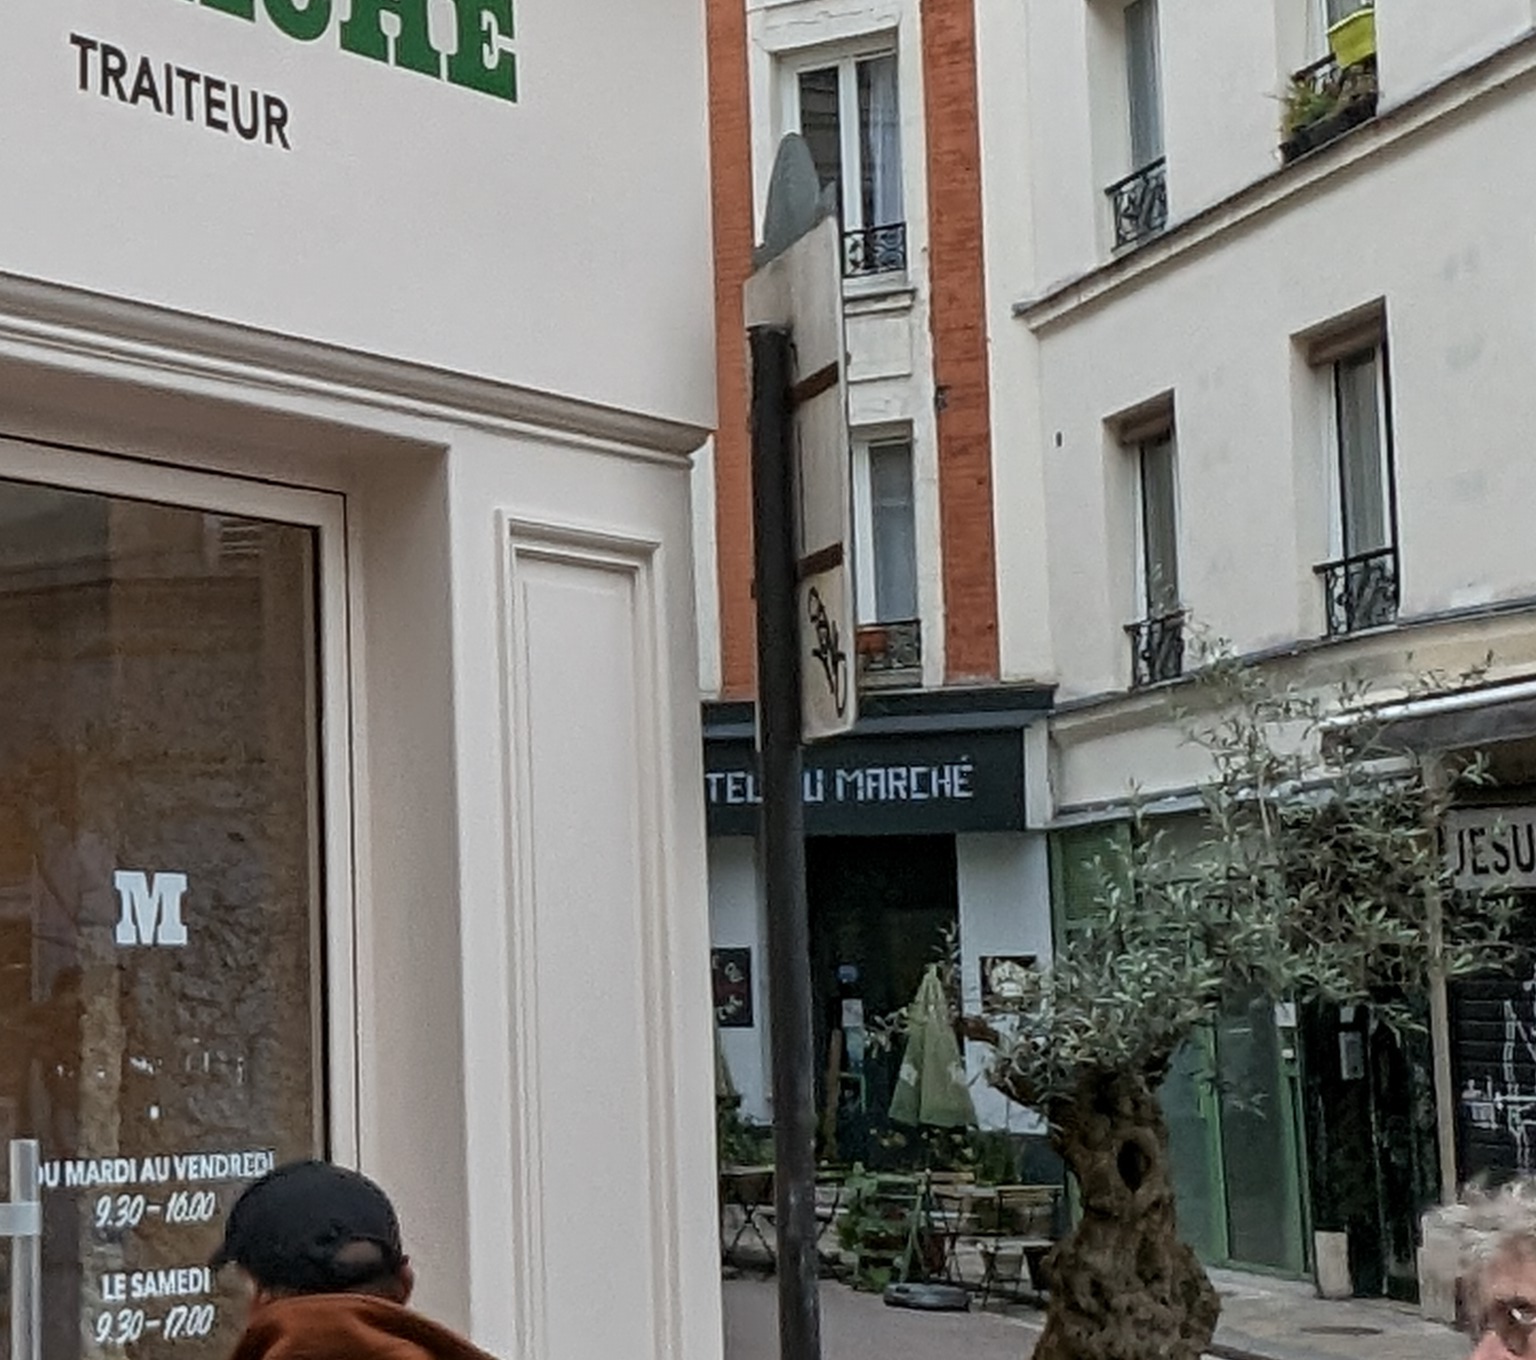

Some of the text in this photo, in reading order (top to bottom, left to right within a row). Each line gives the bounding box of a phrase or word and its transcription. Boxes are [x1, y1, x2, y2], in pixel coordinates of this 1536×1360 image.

[69, 33, 291, 150] TRAITEUR
[705, 770, 763, 803] TEL
[835, 755, 973, 802] MARCHÉ
[114, 871, 188, 945] M
[65, 1157, 136, 1186] MARDI
[140, 1155, 170, 1183] AU
[173, 1150, 275, 1180] VENDREDI
[102, 1267, 211, 1302] LE SAMEDI
